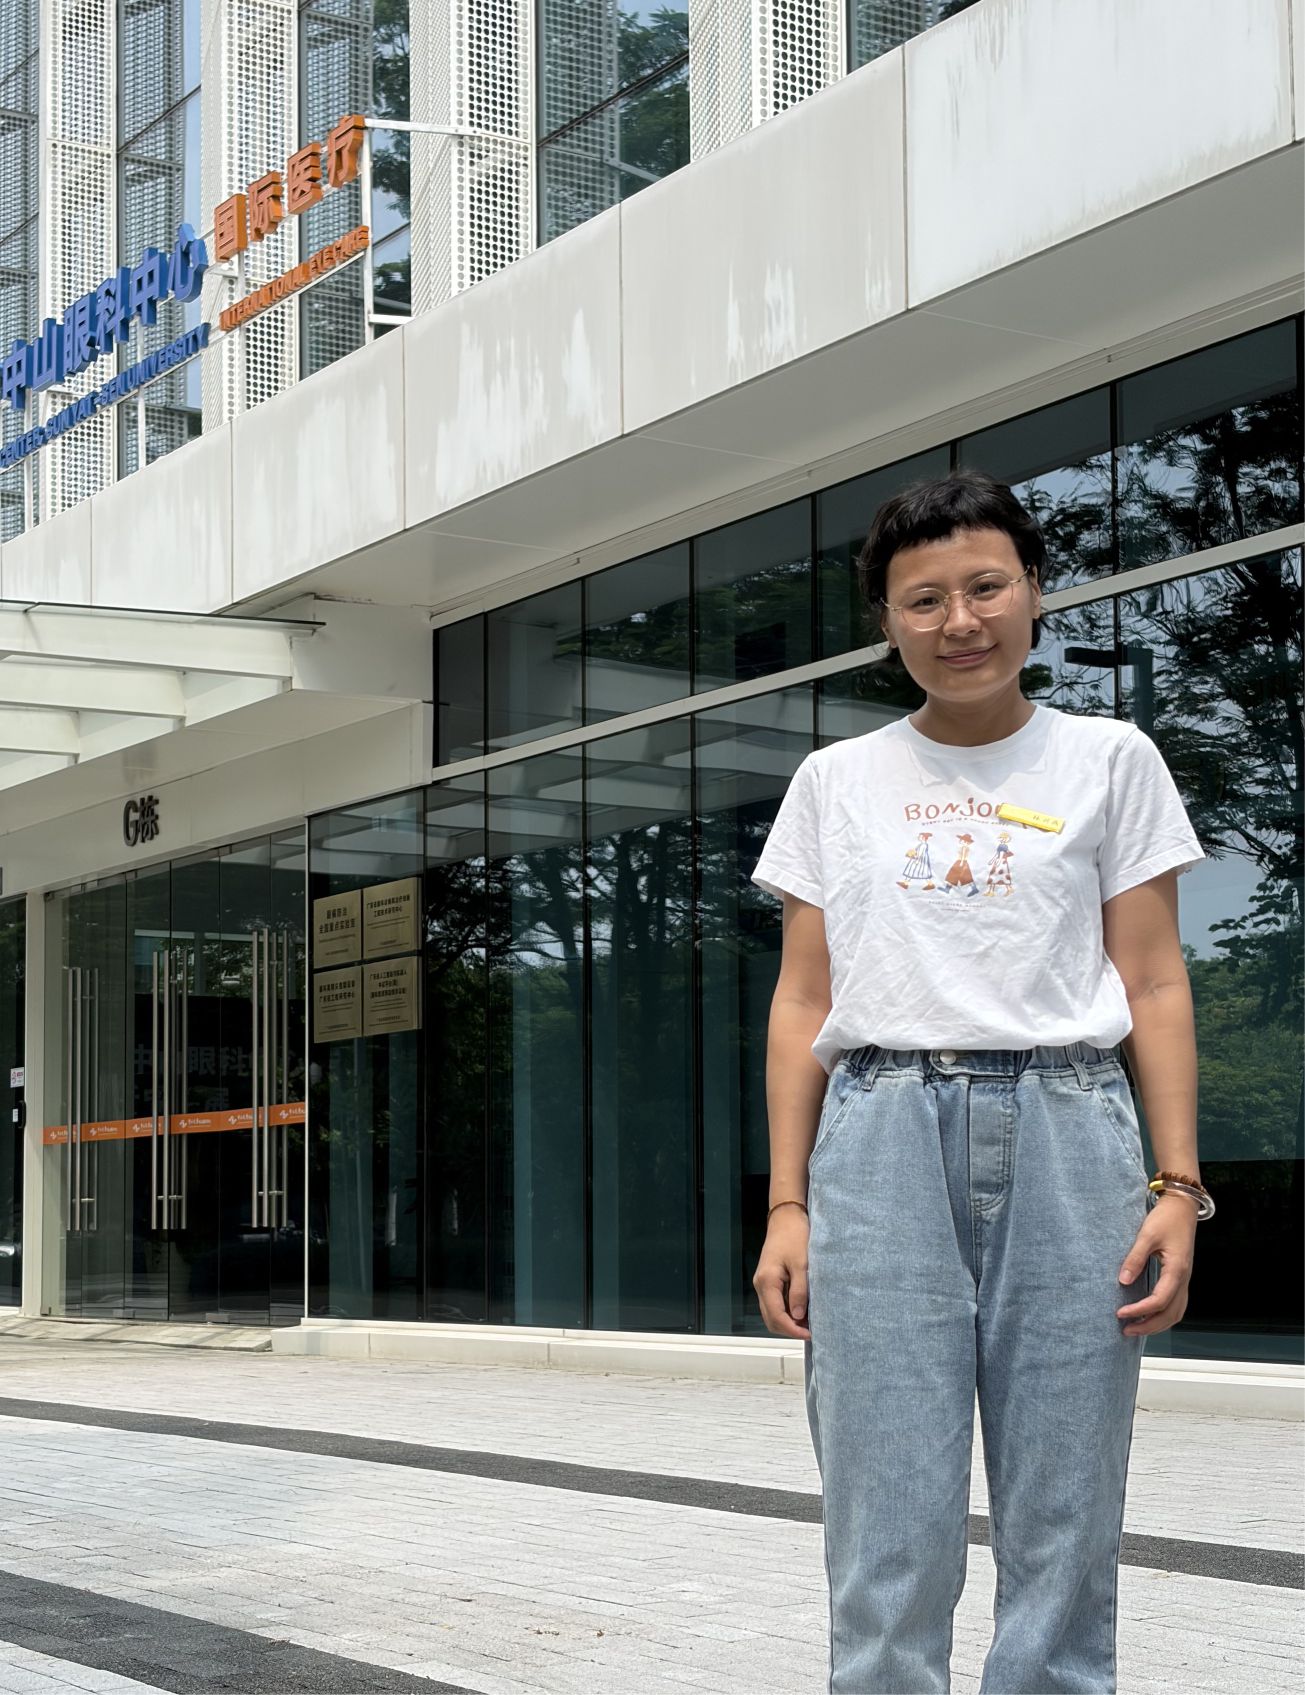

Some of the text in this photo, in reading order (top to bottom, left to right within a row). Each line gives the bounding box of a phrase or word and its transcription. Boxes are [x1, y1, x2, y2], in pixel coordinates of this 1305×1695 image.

[214, 115, 366, 262] 国际医疗
[2, 222, 209, 410] 中山眼科中心
[127, 322, 211, 391] UNIVERSITY
[123, 795, 160, 847] G栋
